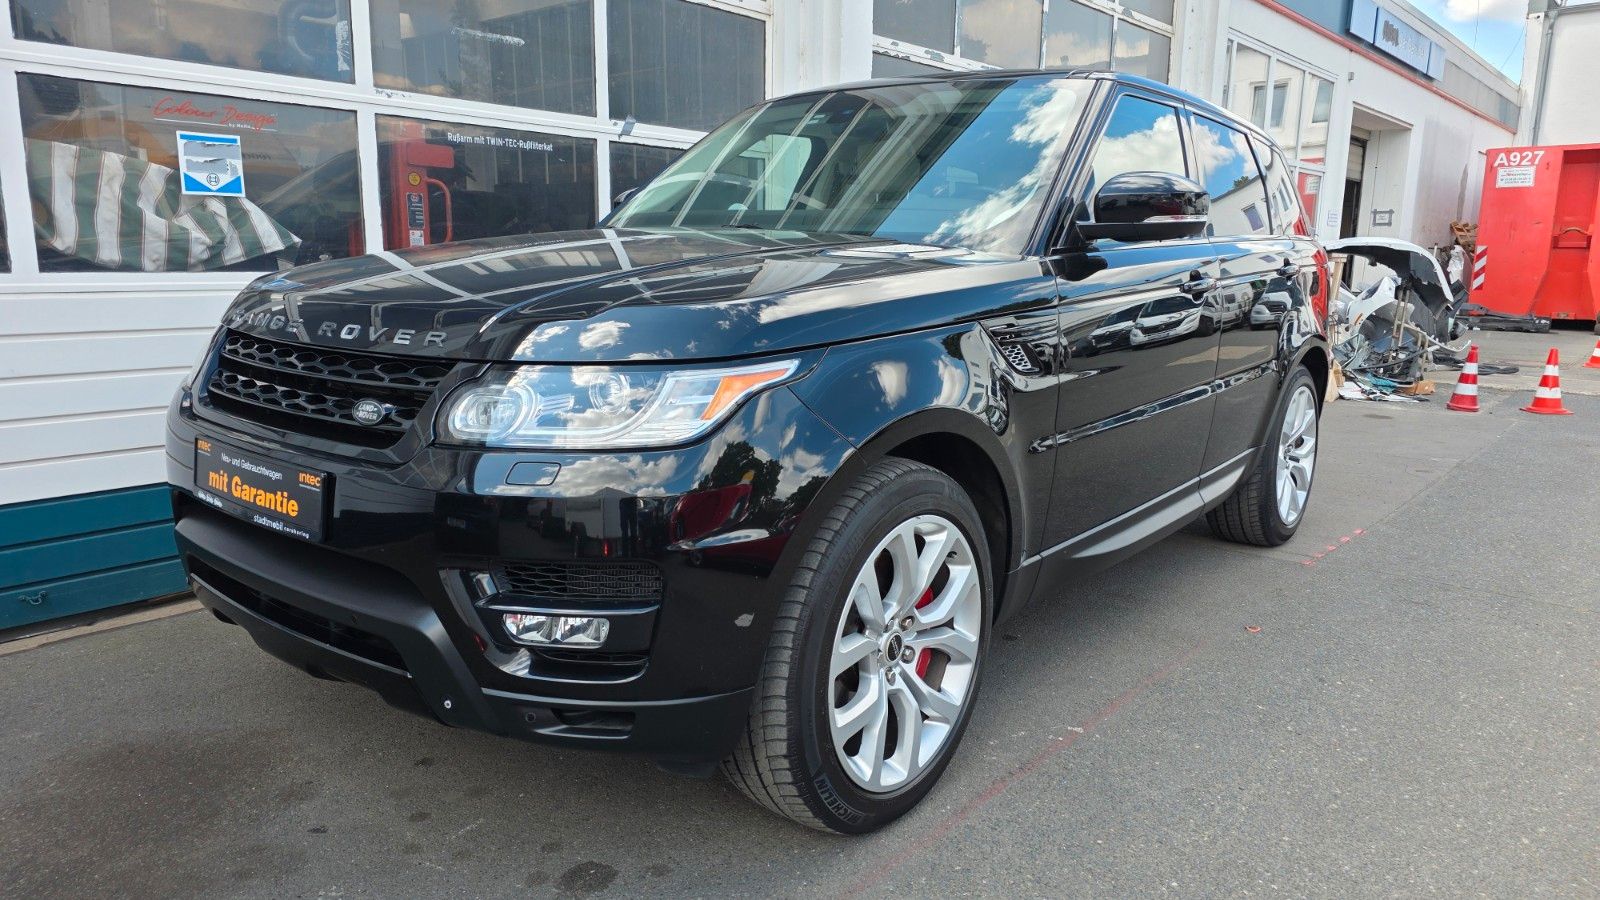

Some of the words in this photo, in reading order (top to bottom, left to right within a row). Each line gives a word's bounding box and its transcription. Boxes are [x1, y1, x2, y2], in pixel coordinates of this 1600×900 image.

[447, 132, 473, 144] Rußarm
[474, 135, 485, 144] mit
[1493, 150, 1545, 167] A927
[317, 321, 448, 348] ROVER
[299, 472, 321, 487] intec
[208, 469, 228, 493] mit
[231, 475, 299, 517] Garantie
[253, 514, 283, 531] stadtmobil
[814, 773, 865, 825] MICHELIN
